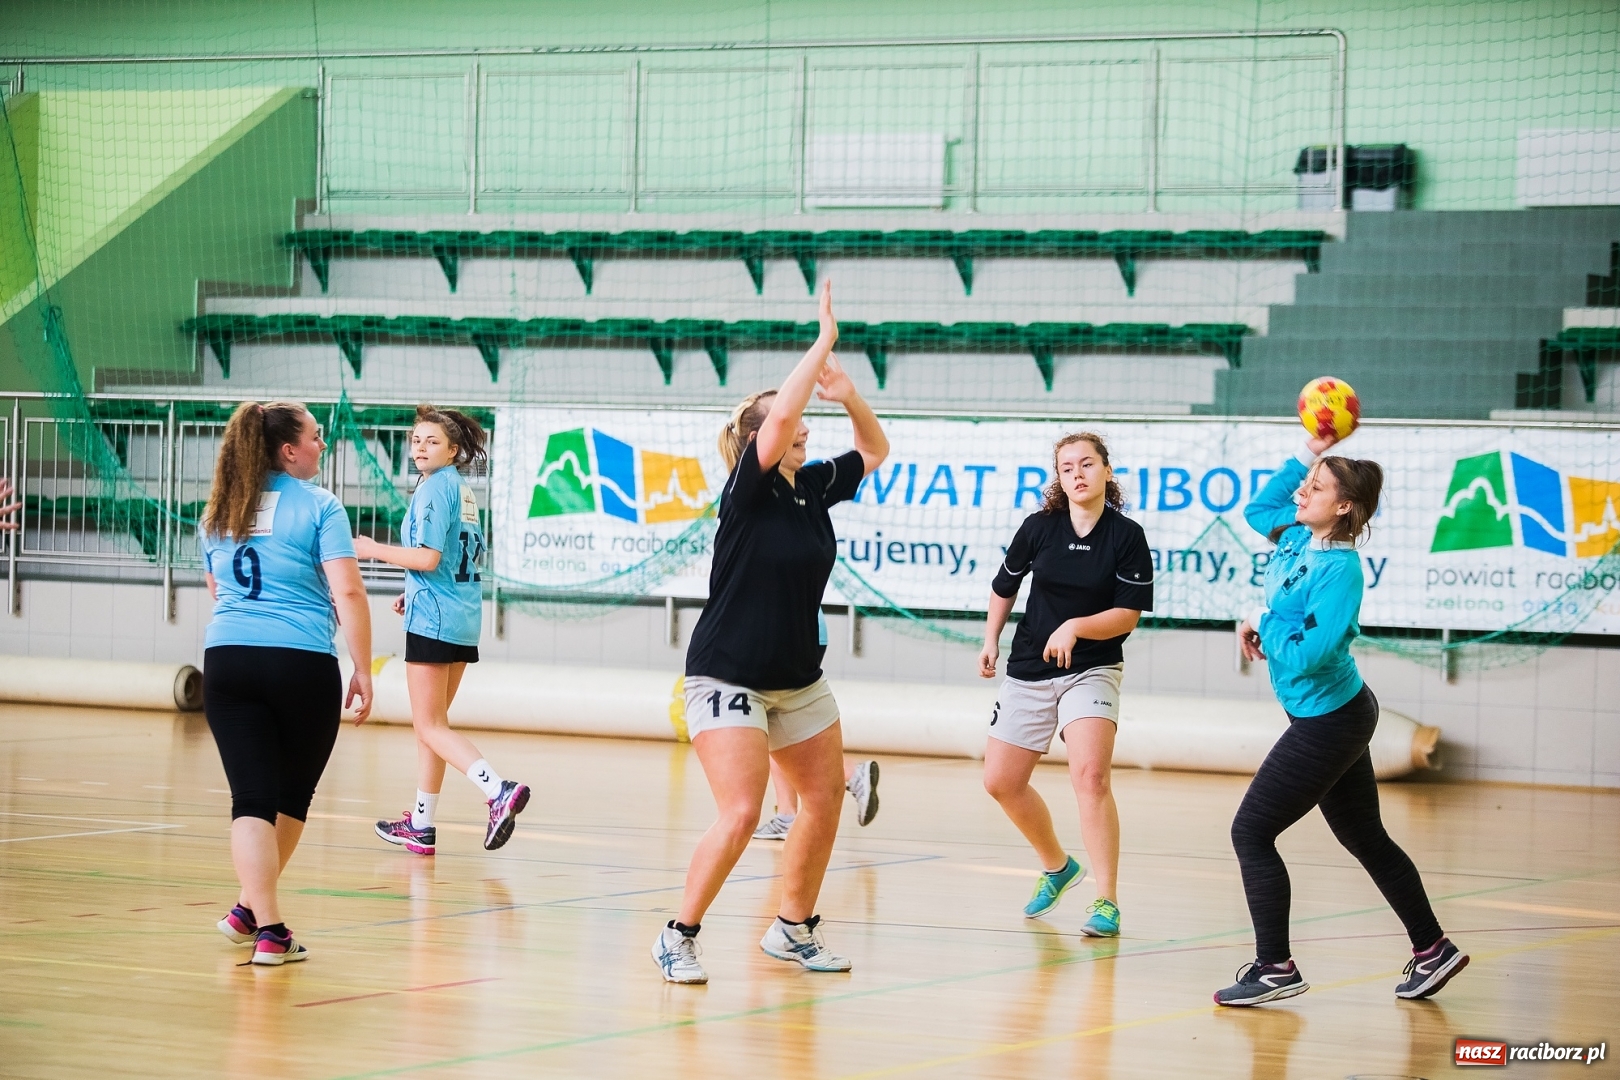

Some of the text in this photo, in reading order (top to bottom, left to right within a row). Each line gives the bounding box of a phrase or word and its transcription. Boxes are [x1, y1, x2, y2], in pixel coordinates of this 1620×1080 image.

[803, 460, 996, 507] WIAT
[523, 527, 713, 556] powiat raciborsk
[233, 544, 262, 601] 9
[521, 557, 587, 572] zielona
[1426, 563, 1516, 591] powiat
[1425, 595, 1504, 612] zielona
[706, 689, 752, 718] 14
